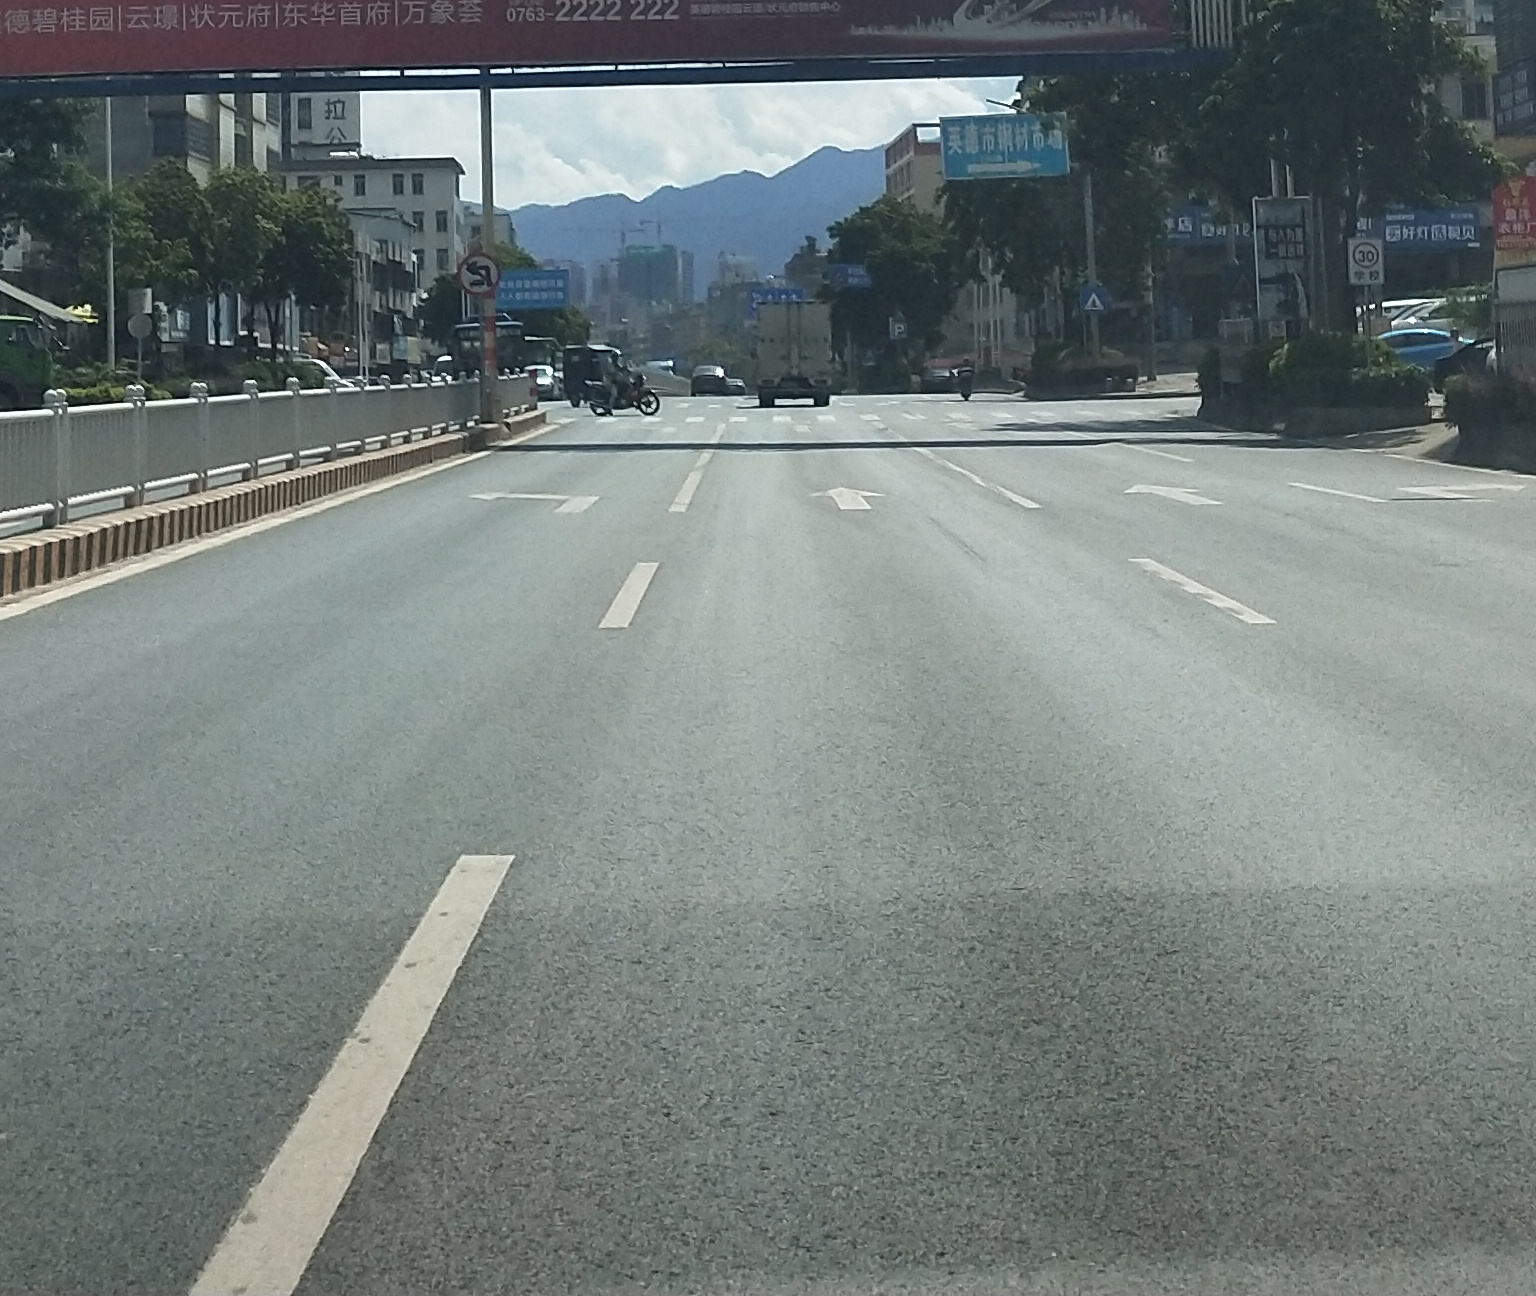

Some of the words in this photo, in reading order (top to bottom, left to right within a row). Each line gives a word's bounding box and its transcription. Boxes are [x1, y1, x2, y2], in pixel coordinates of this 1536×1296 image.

[1357, 249, 1376, 263] 30
[1353, 270, 1380, 282] 学校
[894, 323, 905, 337] P
